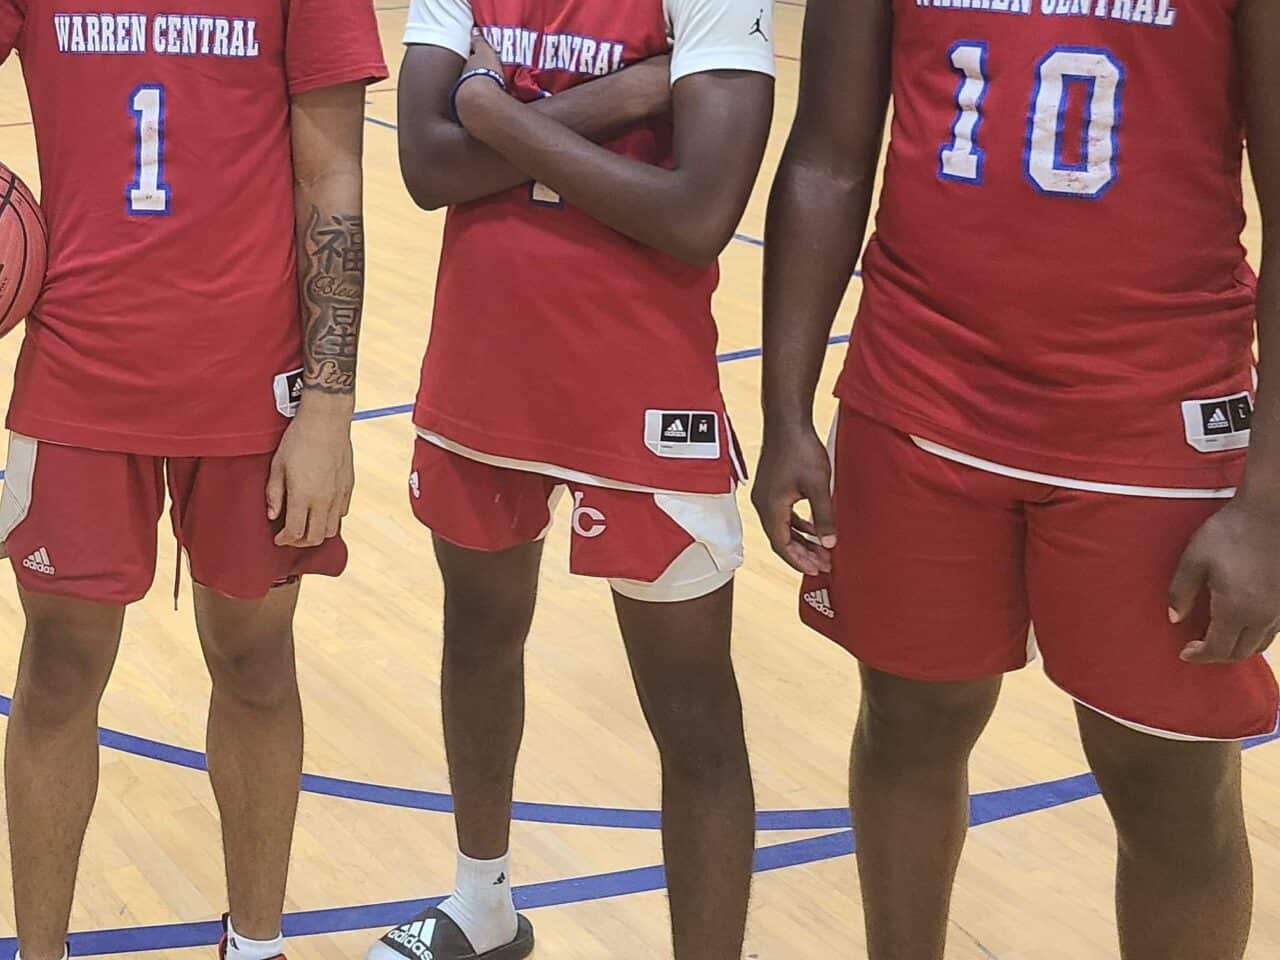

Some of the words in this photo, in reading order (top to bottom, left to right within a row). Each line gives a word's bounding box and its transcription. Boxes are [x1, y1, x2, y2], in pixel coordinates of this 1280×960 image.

[53, 12, 148, 54] WARREN
[152, 14, 259, 58] CENTRAL
[937, 40, 1126, 201] 10
[126, 83, 173, 216] 1
[314, 305, 357, 358] 星
[699, 423, 708, 433] M
[23, 558, 55, 575] adidas
[804, 593, 835, 618] adidas
[388, 929, 433, 960] adidas
